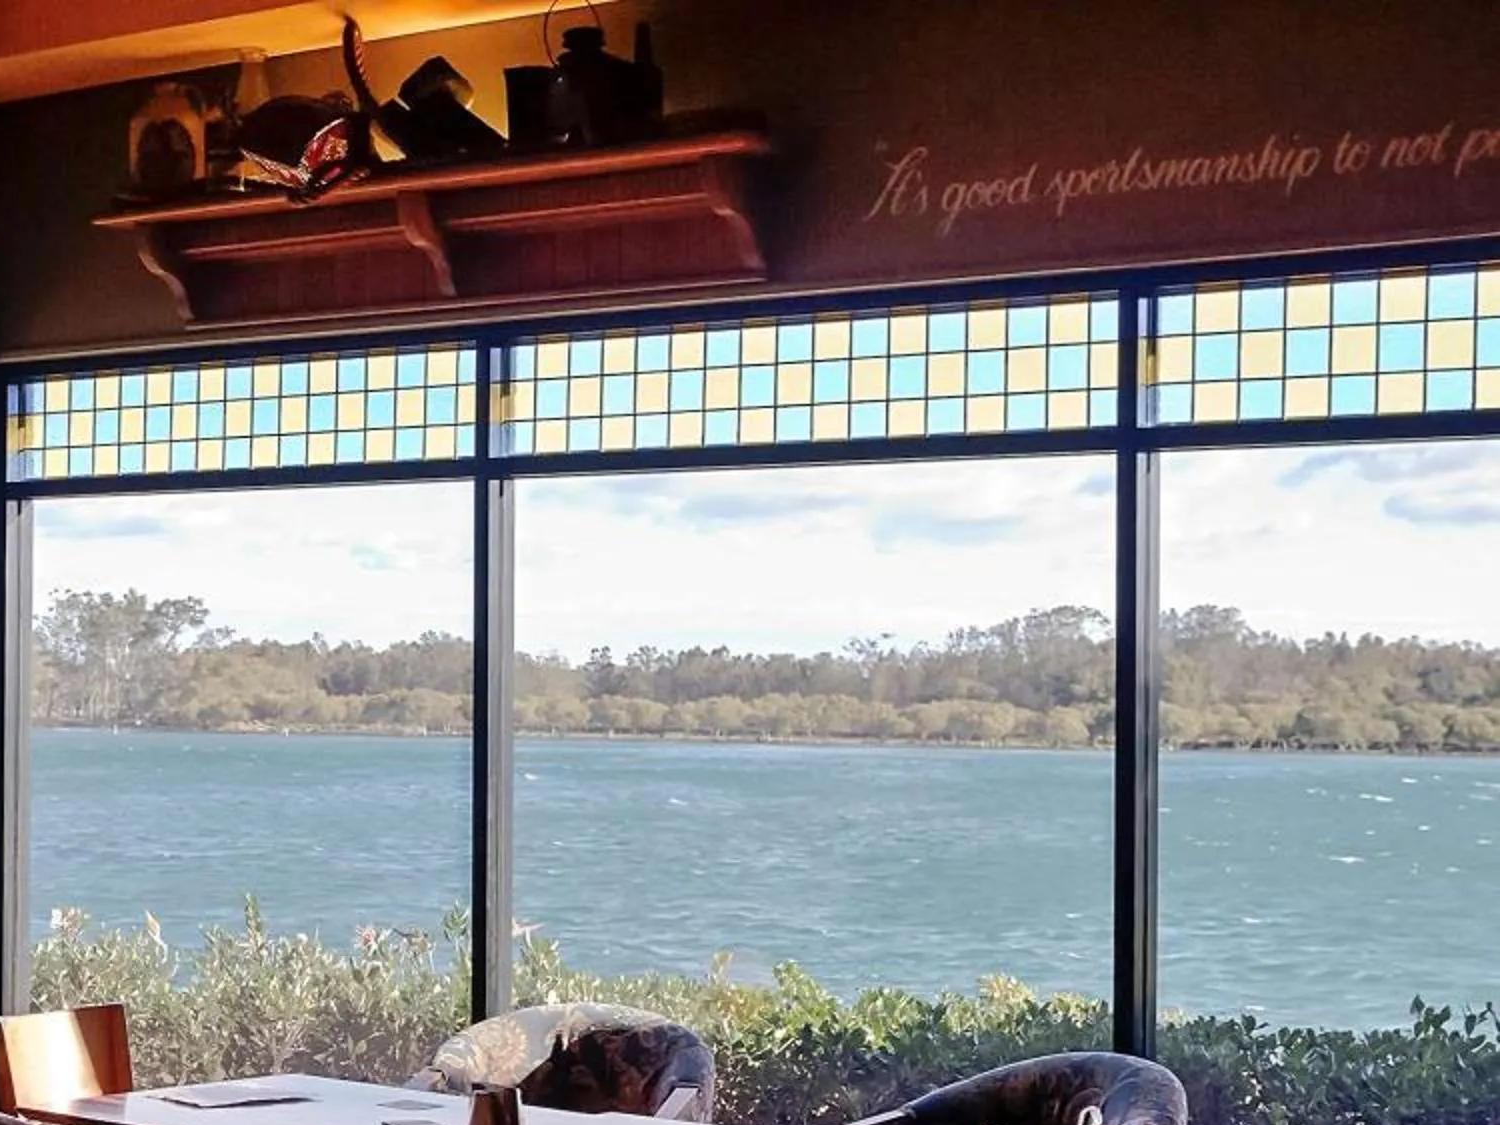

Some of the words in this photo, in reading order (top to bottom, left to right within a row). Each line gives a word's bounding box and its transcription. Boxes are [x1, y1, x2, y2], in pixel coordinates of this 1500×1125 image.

[938, 163, 1039, 237] good
[1045, 131, 1320, 216] sportsmanship
[1334, 131, 1371, 175] to
[1380, 120, 1455, 169] not
